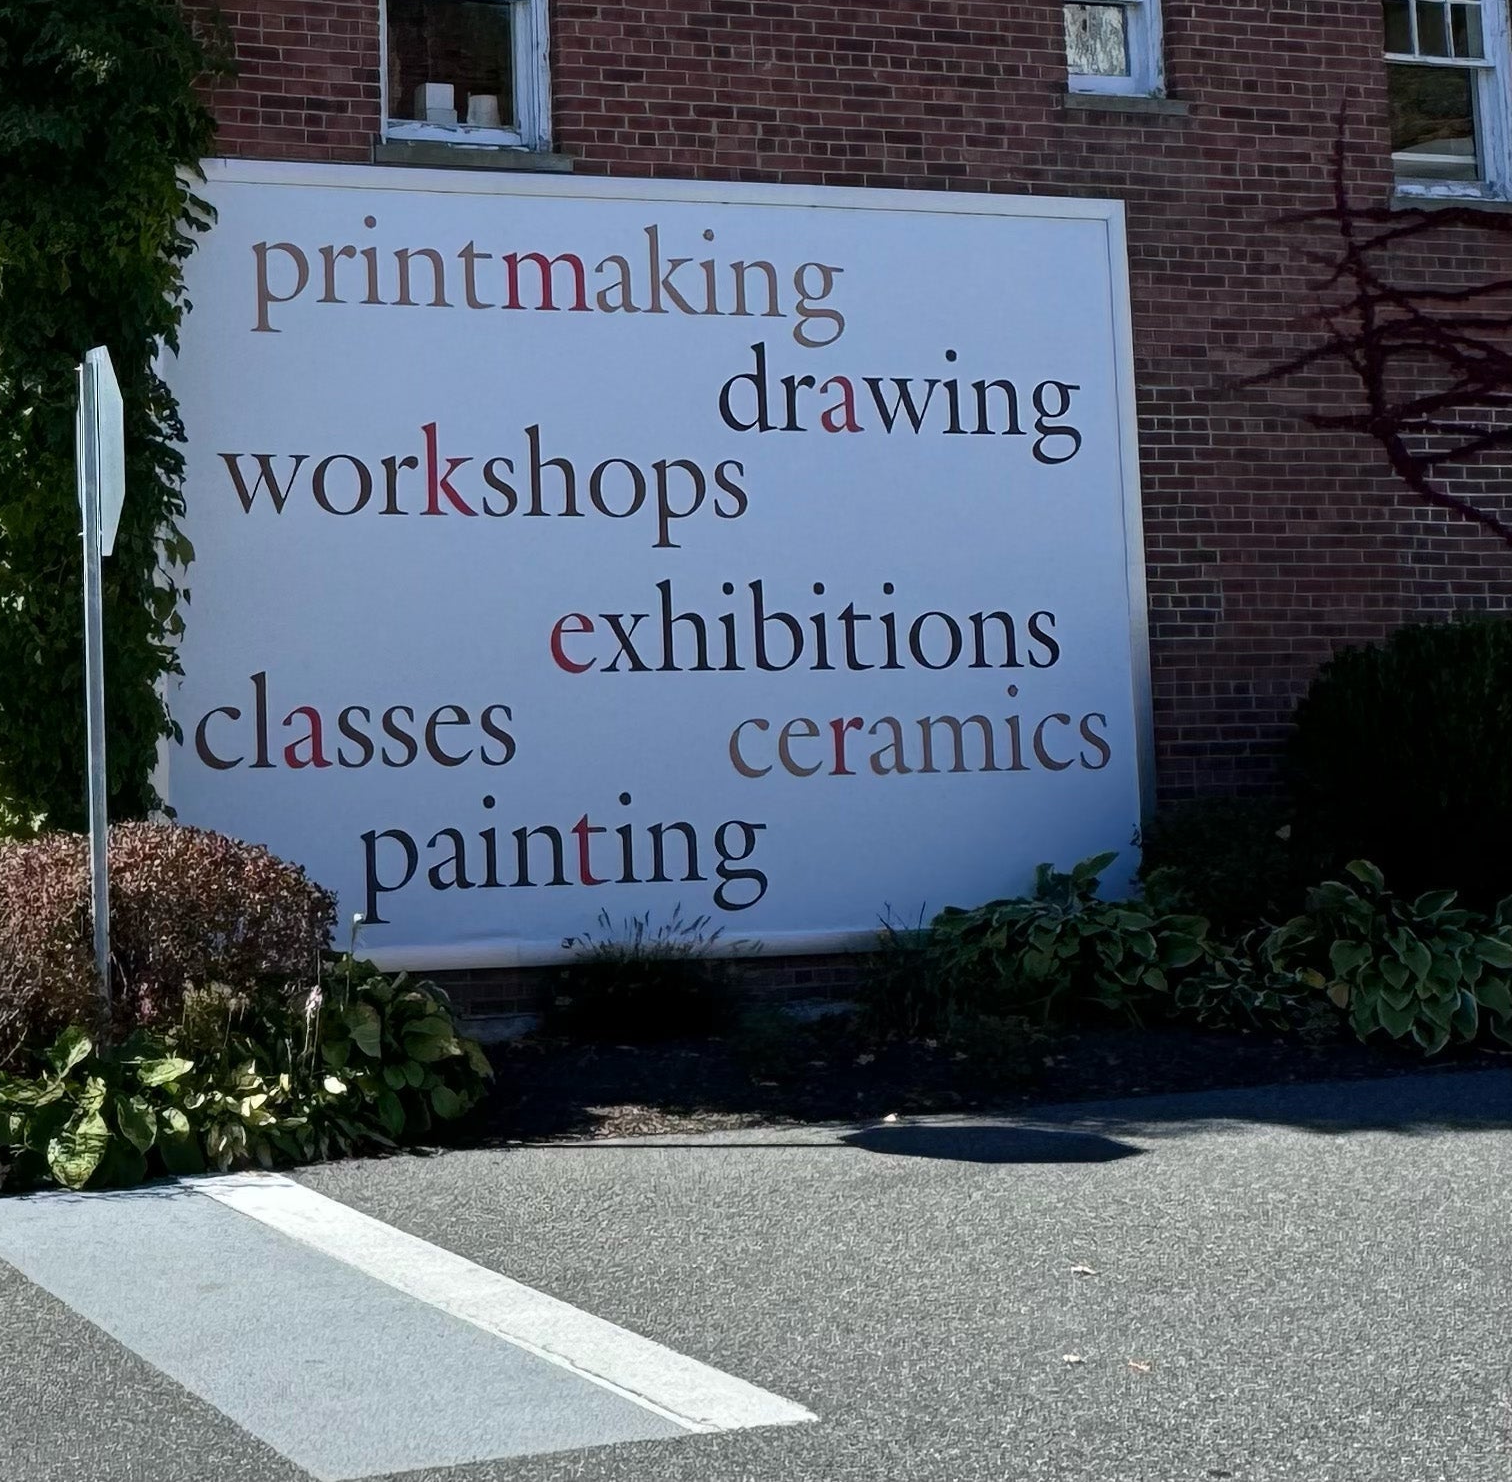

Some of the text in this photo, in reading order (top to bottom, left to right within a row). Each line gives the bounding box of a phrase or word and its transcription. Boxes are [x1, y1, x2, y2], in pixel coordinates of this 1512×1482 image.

[250, 214, 846, 349] printmaking
[718, 341, 1083, 465] drawing
[216, 421, 749, 549] workshops
[550, 578, 1061, 675] exhibitions
[194, 670, 517, 771] classes
[728, 684, 1112, 779] ceramics
[360, 791, 769, 923] painting
